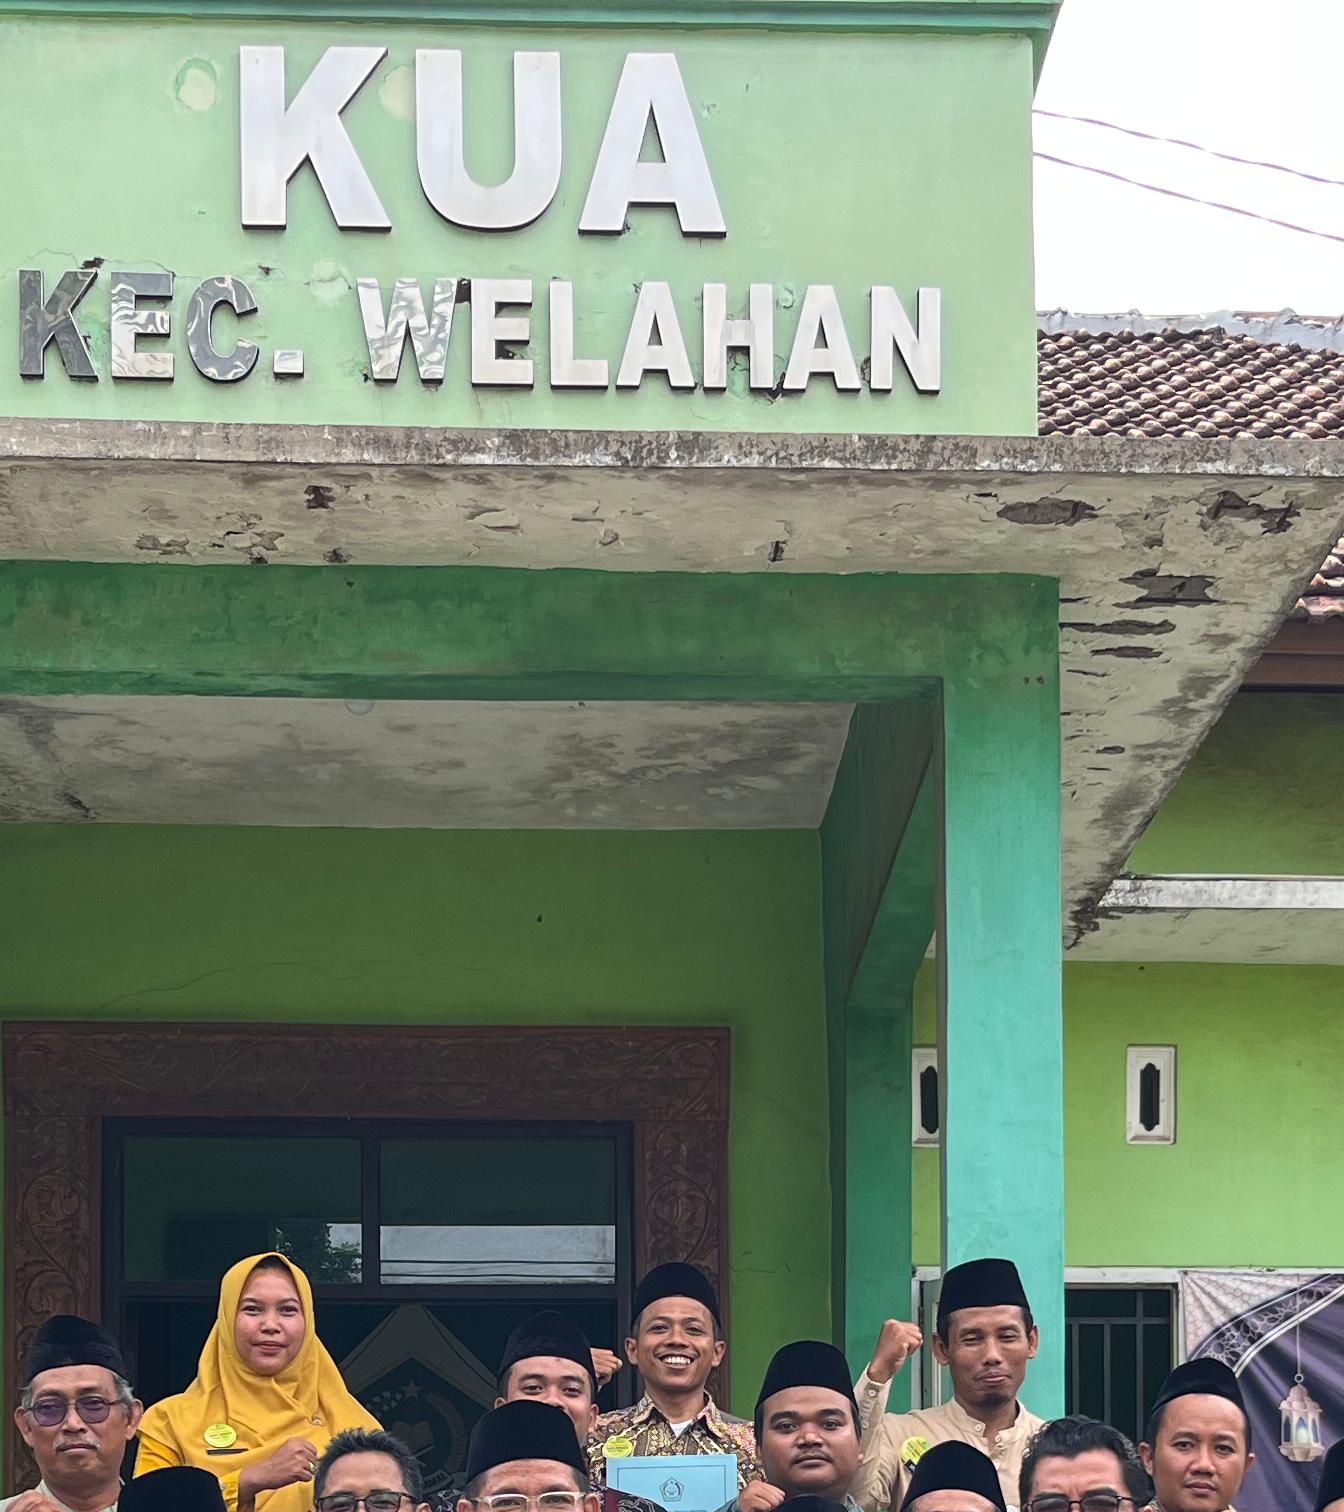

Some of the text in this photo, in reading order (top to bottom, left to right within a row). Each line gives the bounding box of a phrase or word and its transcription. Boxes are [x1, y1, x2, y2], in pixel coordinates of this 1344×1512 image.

[239, 44, 727, 237] KUA
[18, 267, 942, 395] KEC. WELAHAN
